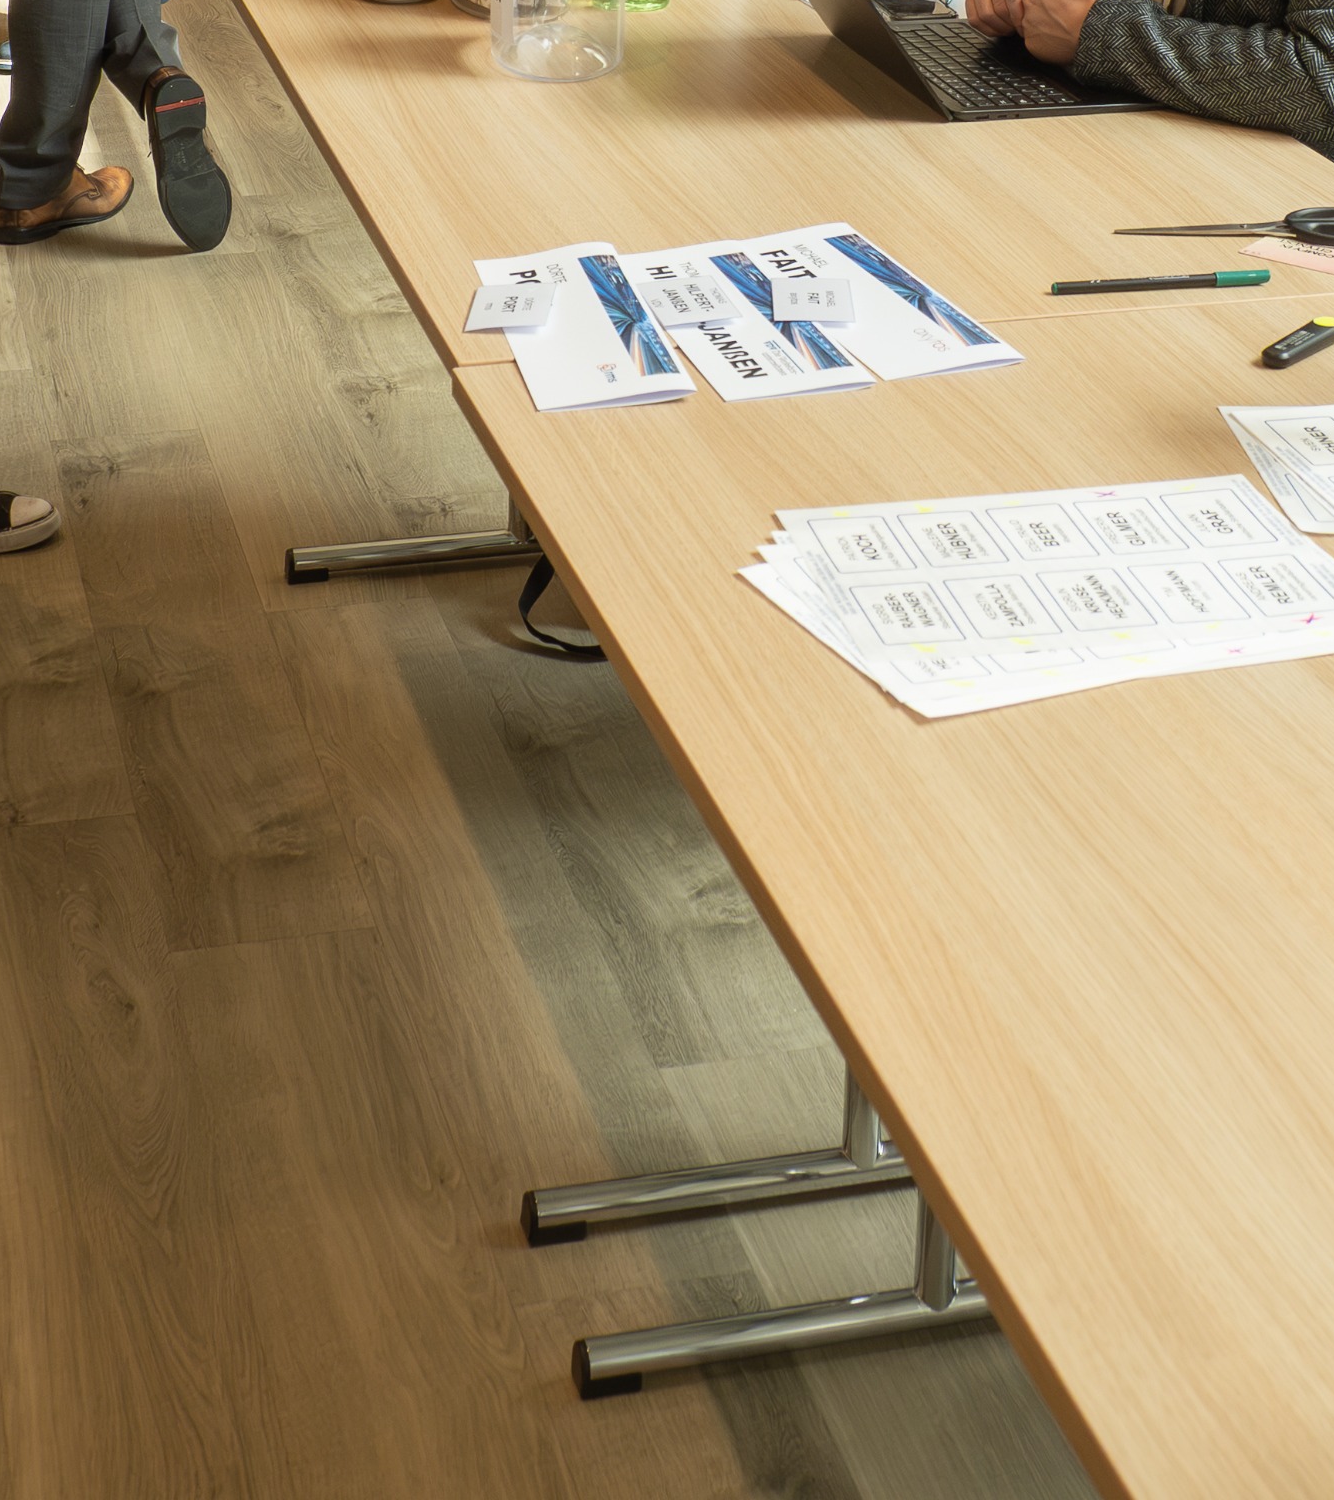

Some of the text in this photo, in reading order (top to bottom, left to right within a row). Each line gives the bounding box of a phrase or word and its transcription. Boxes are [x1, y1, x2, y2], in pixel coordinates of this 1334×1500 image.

[760, 249, 817, 279] FAIT
[793, 244, 828, 268] MICHAEL
[546, 263, 567, 285] DÖRTE
[501, 296, 519, 313] PORT
[684, 283, 715, 312] HILPERT-
[807, 292, 820, 305] FAIT
[1027, 522, 1060, 546] BEER
[1105, 511, 1146, 546] GILMER
[1199, 508, 1234, 533] GRAF
[851, 534, 882, 560] KOCH
[931, 523, 976, 559] HÜBNER
[1069, 584, 1102, 612] KRUSE-
[1082, 575, 1129, 618] HECKMANN
[1163, 570, 1210, 612] HOFFMANN
[1246, 566, 1294, 603] REMLER
[881, 592, 915, 628] RAUBER-
[902, 591, 936, 626] WAGNER
[983, 584, 1025, 626] ZAMPOLLA
